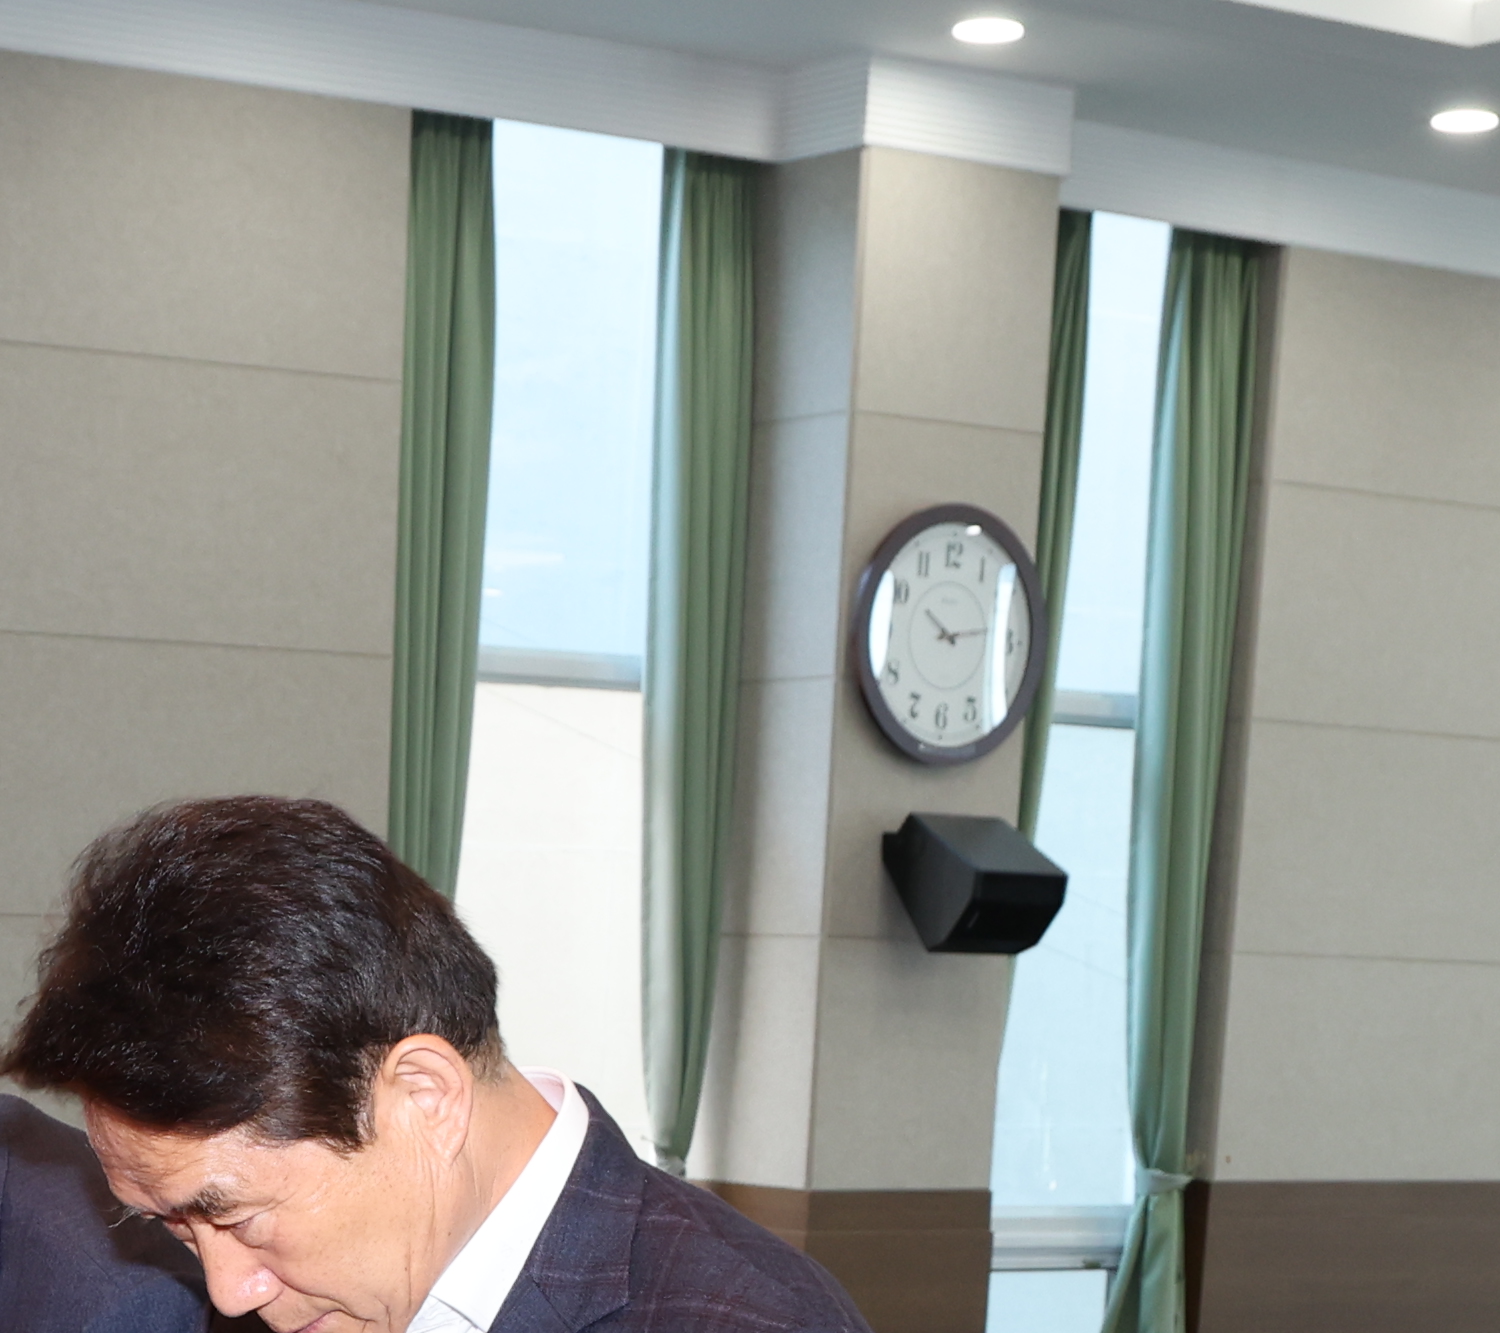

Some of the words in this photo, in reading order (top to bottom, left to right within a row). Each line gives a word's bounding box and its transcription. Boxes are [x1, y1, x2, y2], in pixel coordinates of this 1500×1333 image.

[917, 551, 930, 577] 11
[945, 542, 963, 569] 12
[979, 556, 986, 584] 1
[887, 659, 899, 685] 8
[909, 692, 922, 719] 7
[935, 703, 948, 729] 6
[963, 696, 977, 722] 5
